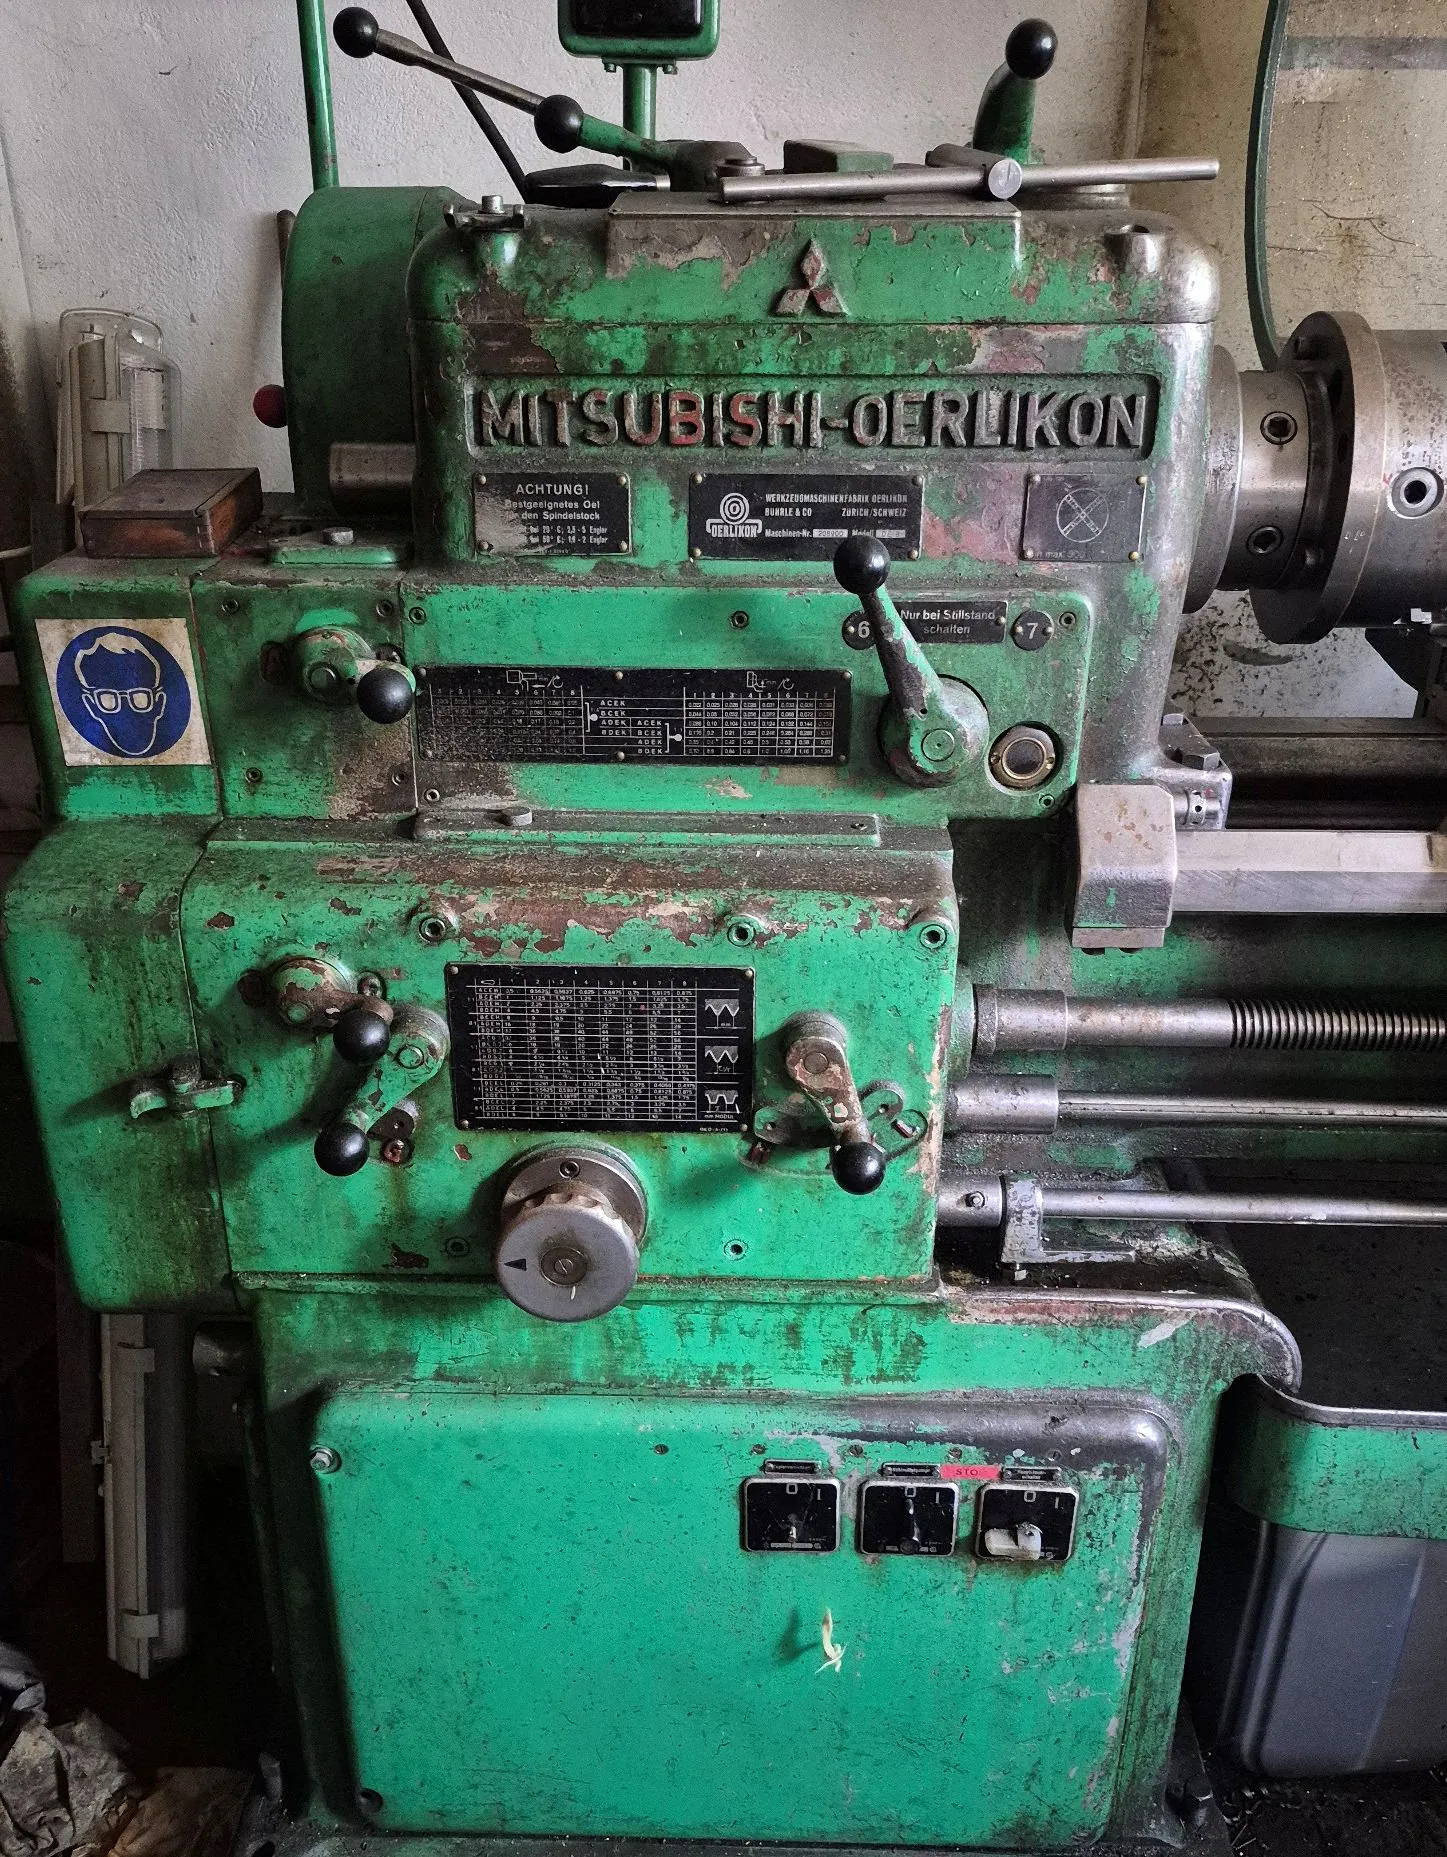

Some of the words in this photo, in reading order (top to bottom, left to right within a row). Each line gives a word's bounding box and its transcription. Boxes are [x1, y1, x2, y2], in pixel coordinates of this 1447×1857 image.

[479, 388, 1148, 449] MITSUBISHI-OERLIKON
[582, 500, 601, 509] Oel
[871, 494, 909, 504] OERLIKON
[521, 510, 539, 520] den
[542, 510, 601, 521] Spindelstock
[794, 507, 802, 517] &
[802, 507, 813, 517] CO
[710, 523, 759, 539] OERLIKON
[900, 609, 921, 620] Nur
[922, 609, 941, 620] bei
[943, 609, 996, 620] Stillstand
[857, 620, 871, 639] 6
[923, 623, 971, 634] schalten
[1027, 622, 1042, 640] 7
[600, 699, 626, 707] ACEK
